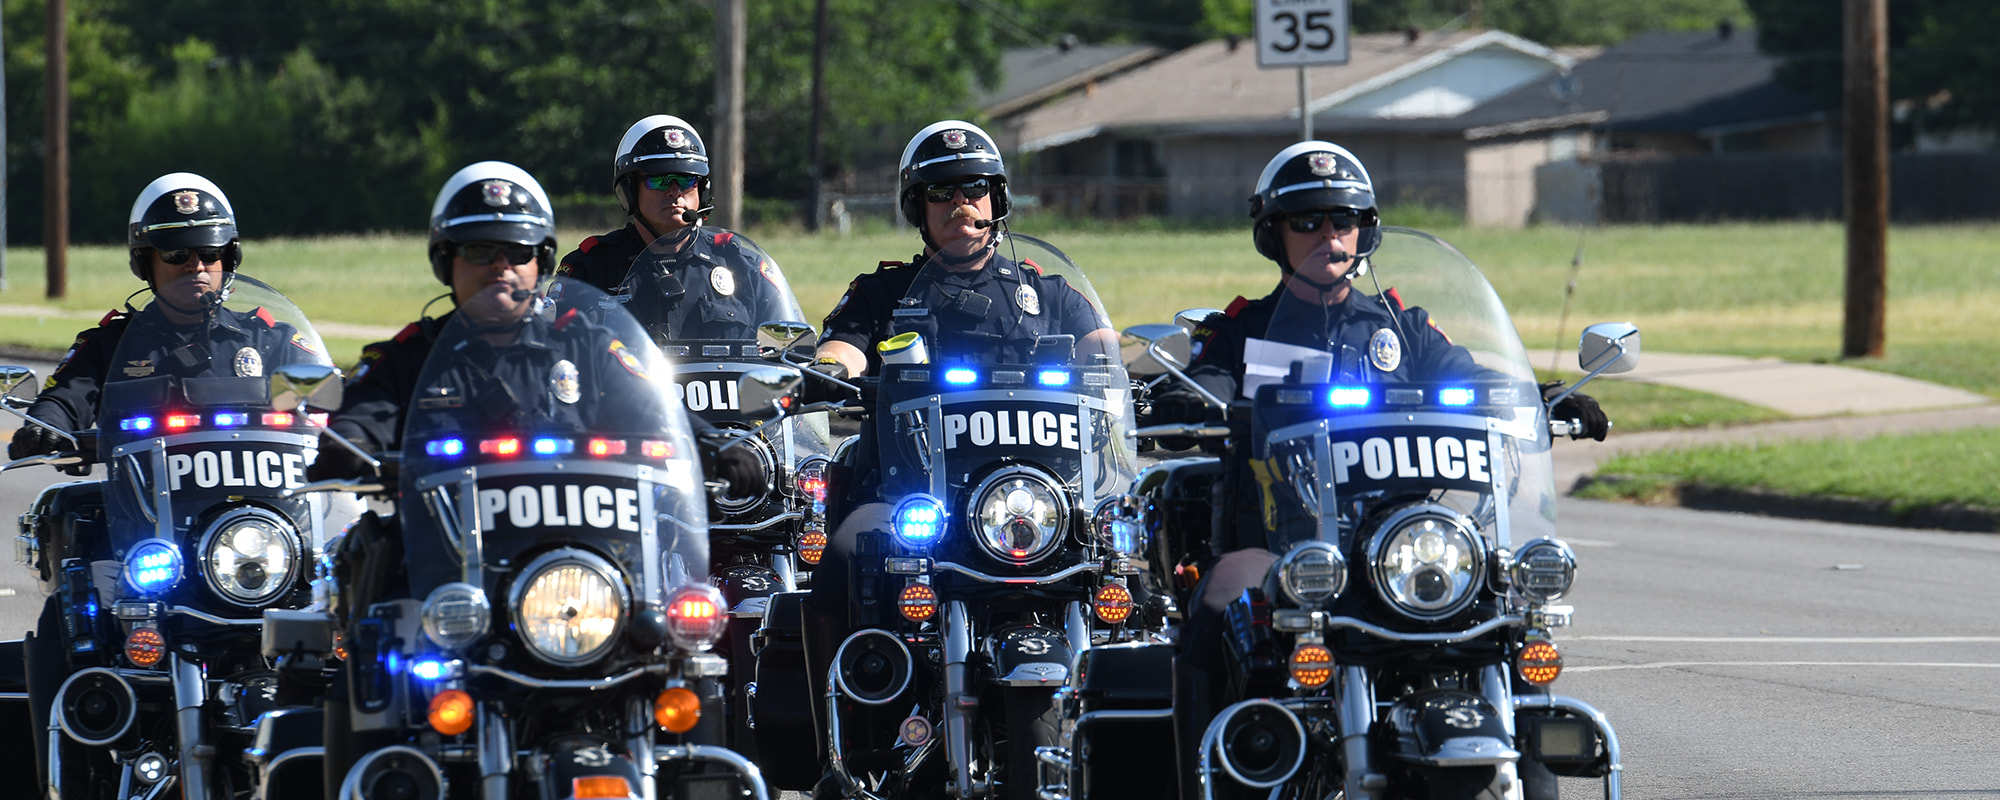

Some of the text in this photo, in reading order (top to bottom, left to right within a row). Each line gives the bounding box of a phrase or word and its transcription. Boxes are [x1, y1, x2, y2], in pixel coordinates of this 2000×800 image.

[1271, 10, 1335, 52] 35
[943, 410, 1080, 450] POLICE
[168, 450, 306, 491] POLICE
[1332, 436, 1491, 484] POLICE
[479, 484, 640, 532] POLICE
